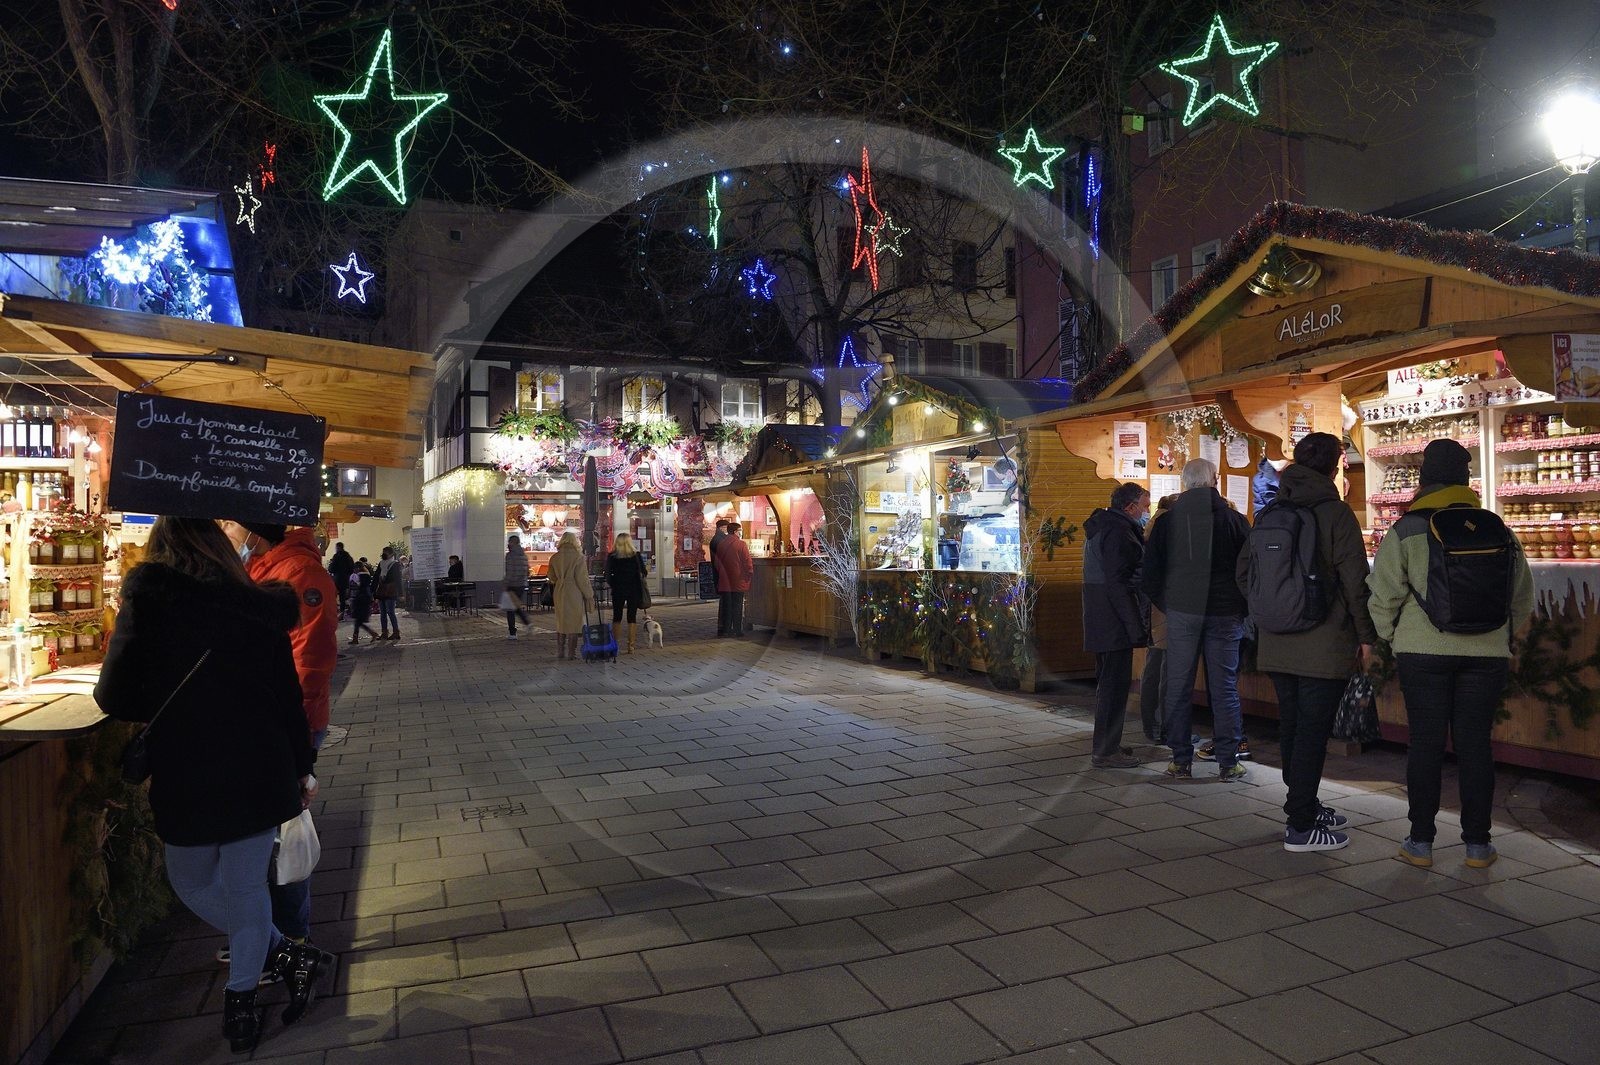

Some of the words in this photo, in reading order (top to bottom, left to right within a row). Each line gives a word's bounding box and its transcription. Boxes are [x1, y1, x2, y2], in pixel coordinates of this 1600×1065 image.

[137, 399, 172, 429] Jus
[172, 411, 195, 426] de
[196, 416, 247, 435] pomme
[249, 420, 301, 440] chaud
[181, 429, 194, 440] à
[201, 432, 220, 443] la
[208, 444, 223, 456] Le
[224, 449, 261, 461] verre
[272, 499, 309, 517] 2.50
